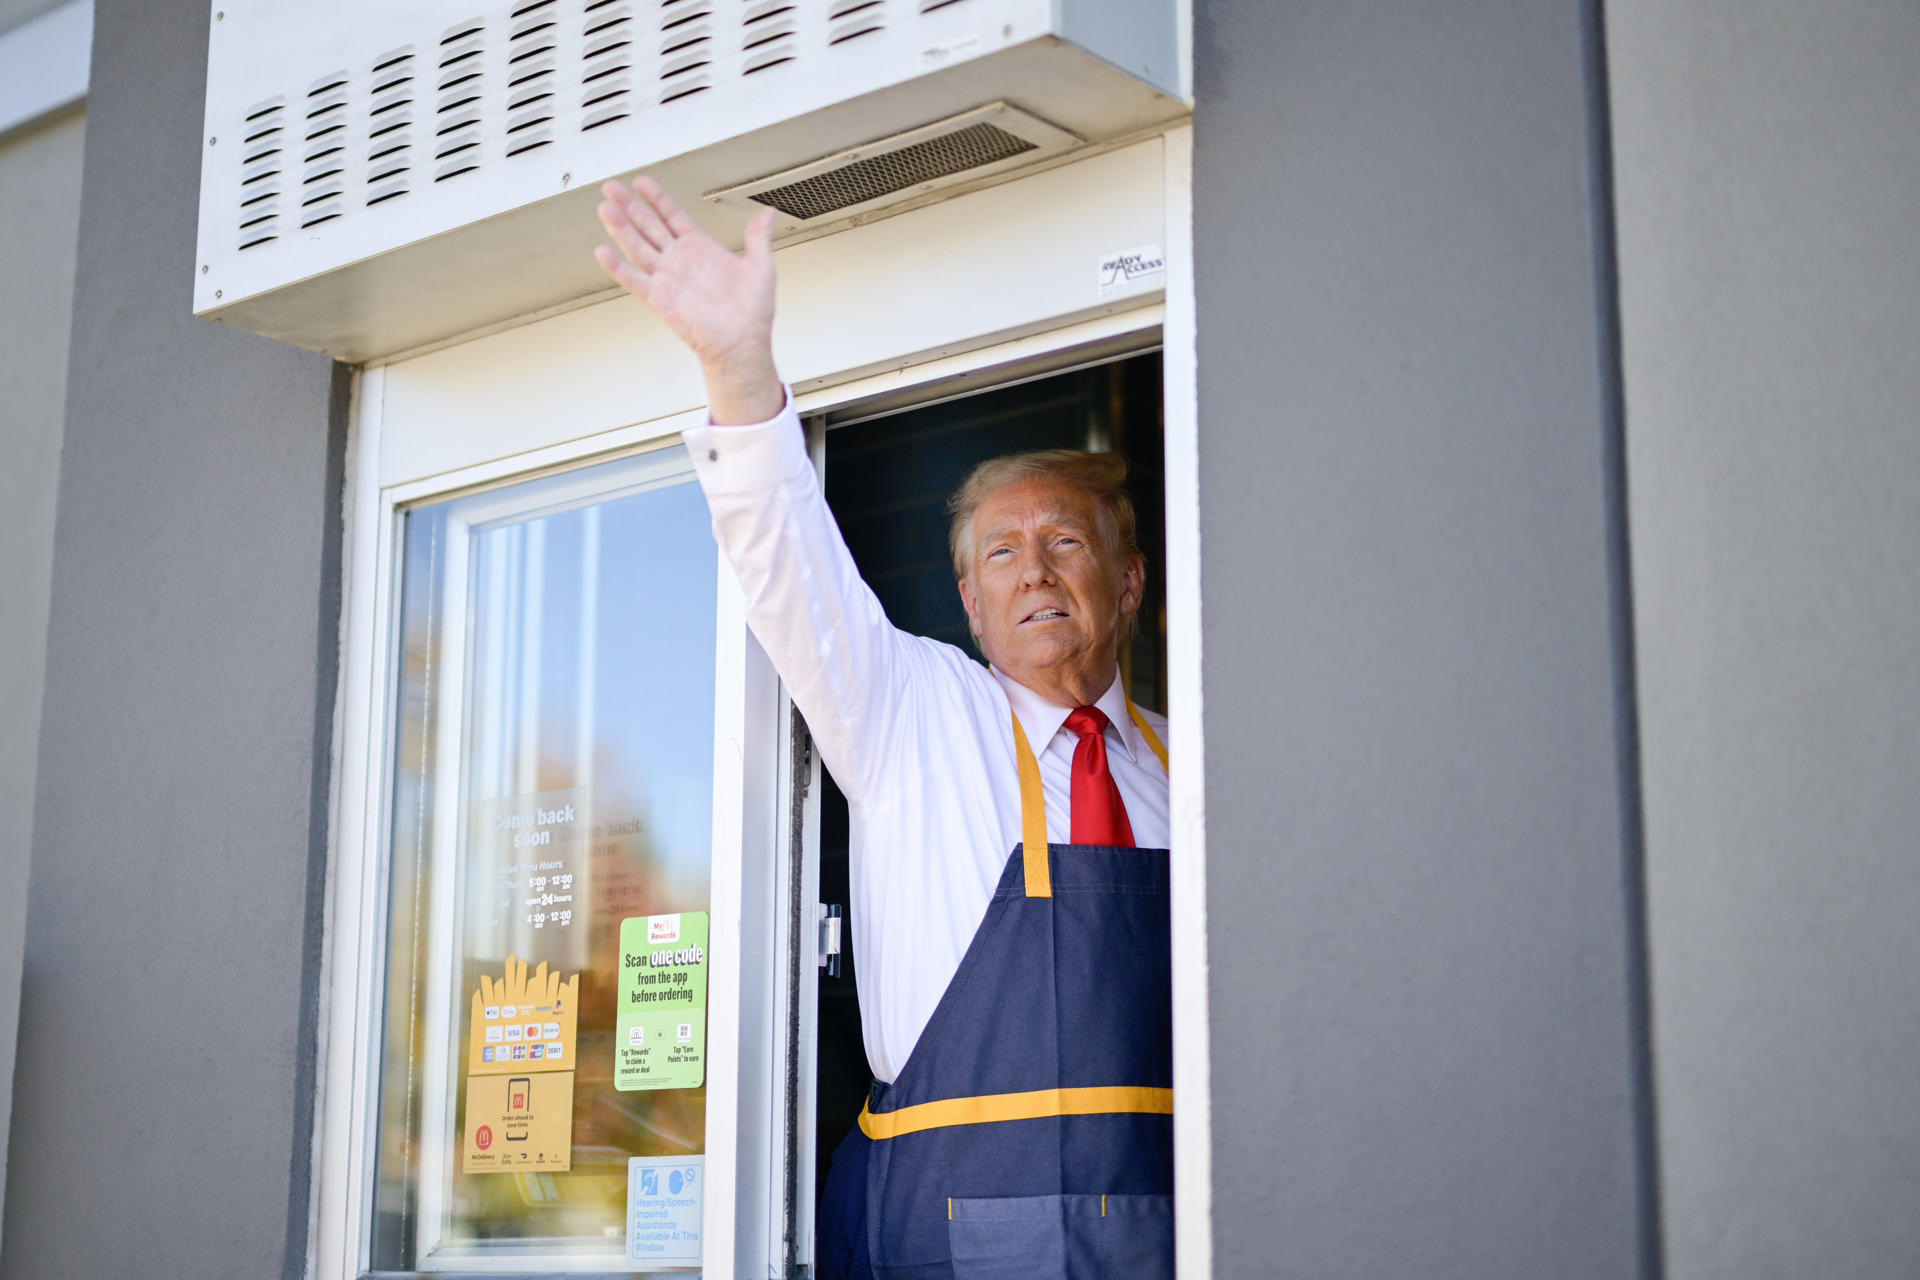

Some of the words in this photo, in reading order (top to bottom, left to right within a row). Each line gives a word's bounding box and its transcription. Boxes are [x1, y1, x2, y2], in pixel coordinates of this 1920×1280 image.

[537, 804, 575, 825] back
[513, 830, 550, 848] soon
[539, 860, 564, 870] Hours
[552, 873, 573, 885] 12:00
[541, 893, 554, 906] 24
[554, 895, 573, 903] hours
[551, 909, 572, 922] 12:00
[651, 932, 677, 940] Rewards
[625, 953, 648, 968] Scan
[650, 949, 673, 968] one
[673, 942, 703, 966] code
[637, 972, 657, 986] from
[657, 970, 672, 984] the
[672, 971, 688, 987] app
[631, 989, 657, 1003] before
[658, 987, 694, 1003] ordering
[507, 1029, 520, 1037] VISA
[636, 1221, 677, 1230] Assistance
[635, 1231, 670, 1241] Available
[671, 1231, 680, 1241] At
[682, 1230, 699, 1241] This
[635, 1242, 665, 1252] Window
